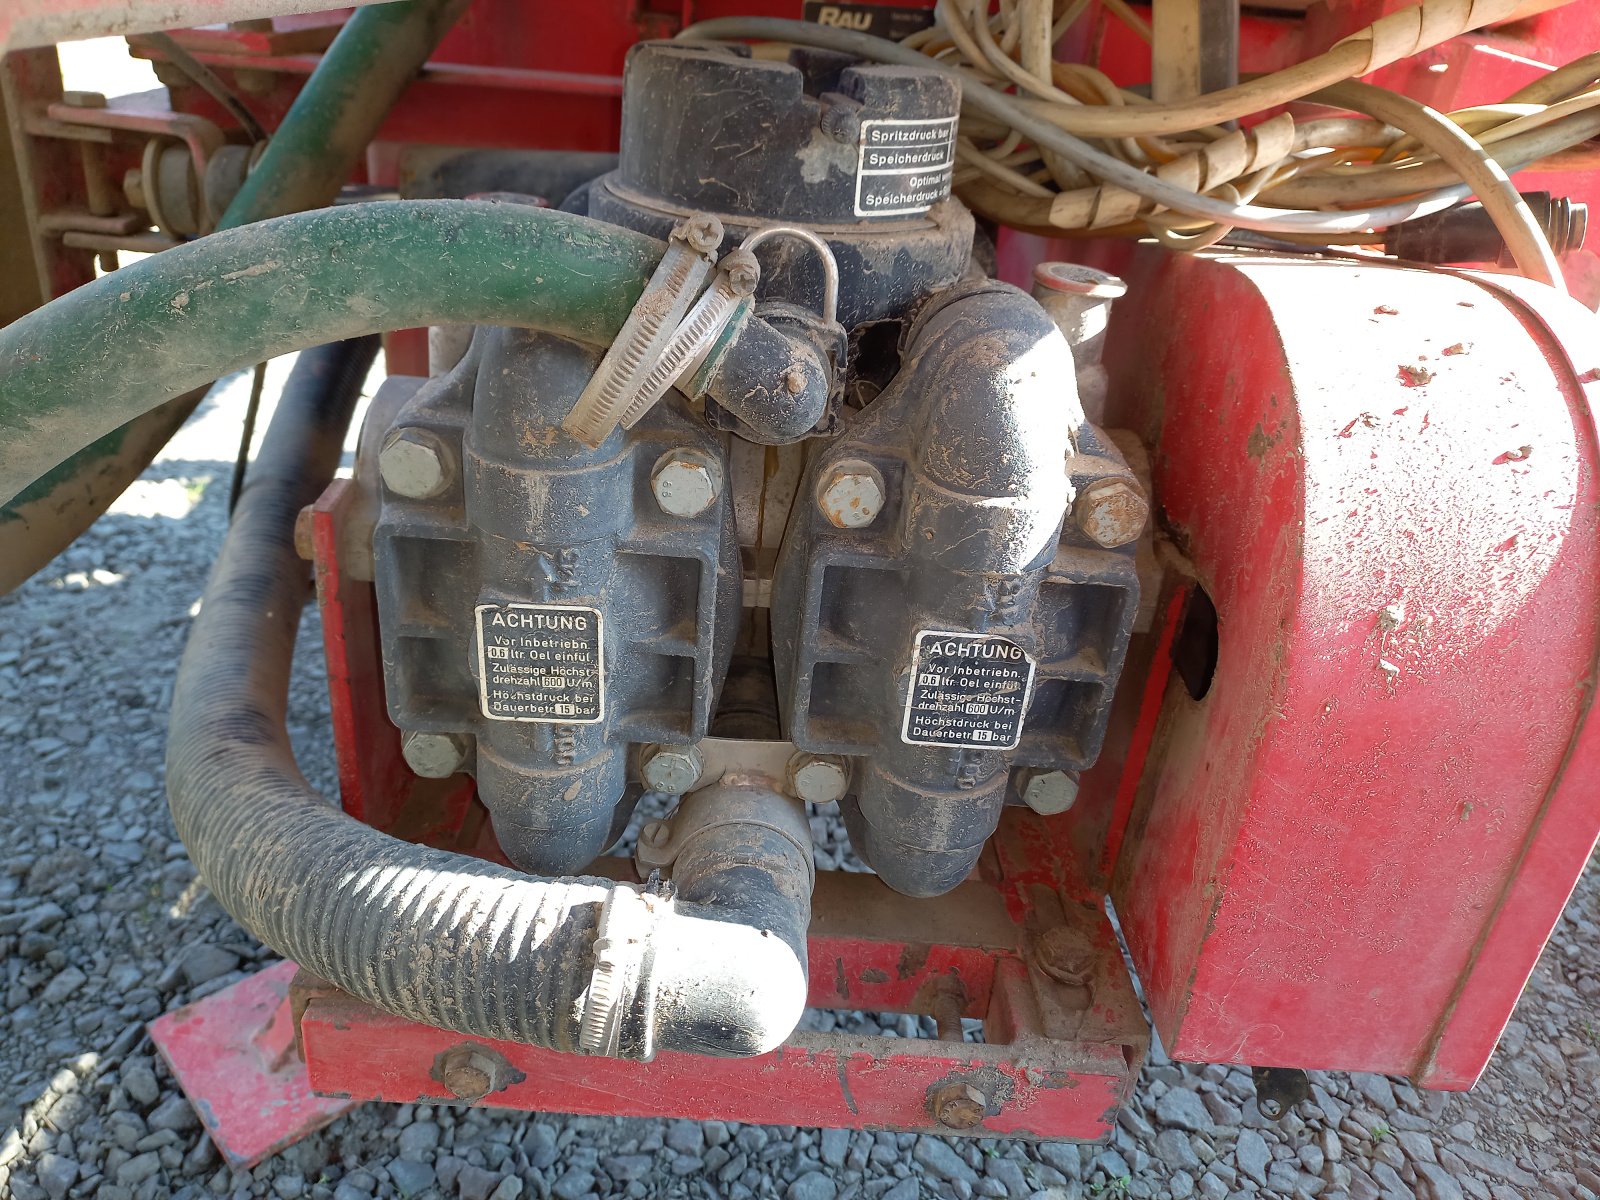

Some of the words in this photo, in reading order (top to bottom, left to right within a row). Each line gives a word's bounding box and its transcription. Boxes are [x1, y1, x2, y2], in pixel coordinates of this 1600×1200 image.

[818, 6, 873, 31] RAU
[871, 129, 936, 142] Spritzdruck
[869, 151, 944, 166] Speicherdruck
[909, 174, 941, 188] Optimal
[866, 189, 937, 207] Speicherdruck
[491, 612, 588, 631] ACHTUNG
[494, 635, 516, 646] Vor
[490, 647, 507, 659] 0.6
[529, 650, 551, 661] Oel
[929, 641, 1023, 660] ACHTUNG
[492, 663, 546, 677] Zulässige
[928, 662, 950, 674] Vor
[953, 665, 1021, 679] Inbetriebn.
[492, 675, 541, 687] drehzahl
[543, 677, 563, 687] 600
[959, 678, 980, 688] Oel
[493, 690, 570, 702] Höchstdruck
[575, 693, 594, 703] bei
[557, 704, 573, 714] 15
[918, 701, 965, 713] drehzahl
[966, 704, 987, 714] 600
[915, 715, 990, 729] Höchstdruck
[994, 720, 1012, 730] bei
[974, 730, 991, 741] 15
[992, 731, 1012, 742] bar
